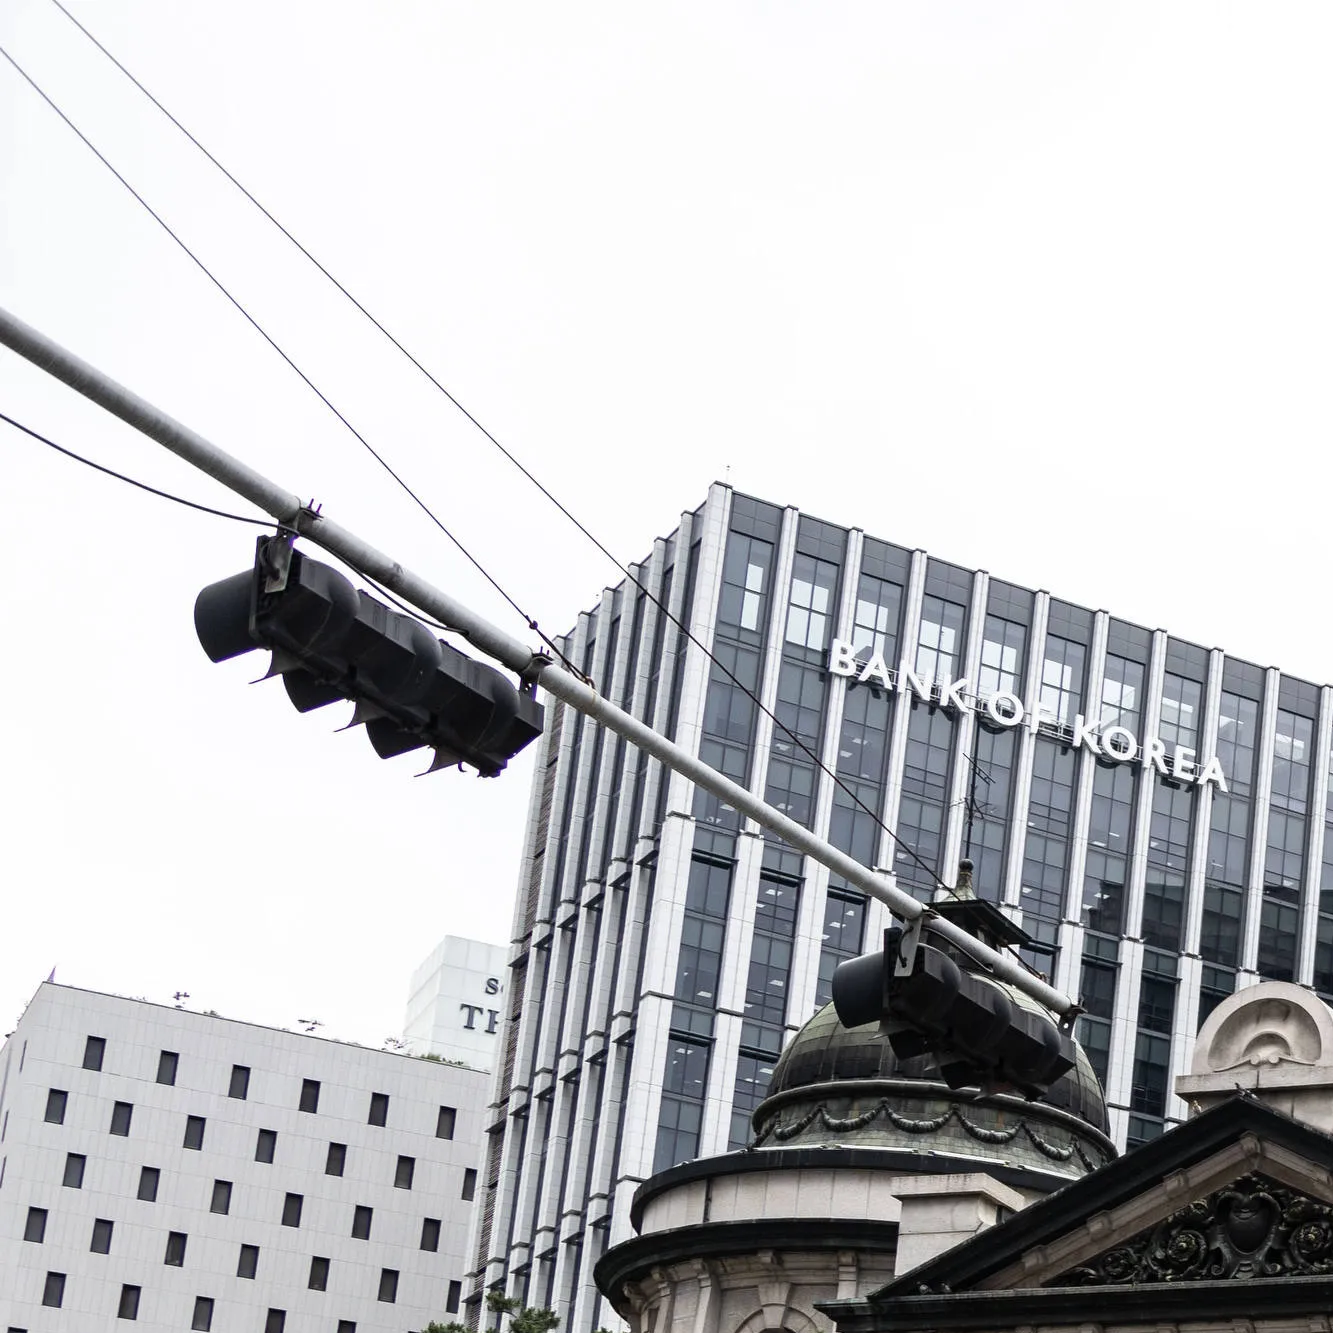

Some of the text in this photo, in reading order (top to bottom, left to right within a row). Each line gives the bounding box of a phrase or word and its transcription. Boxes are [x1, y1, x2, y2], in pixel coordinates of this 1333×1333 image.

[828, 638, 1229, 794] BANK OF KOREA
[484, 977, 504, 995] S
